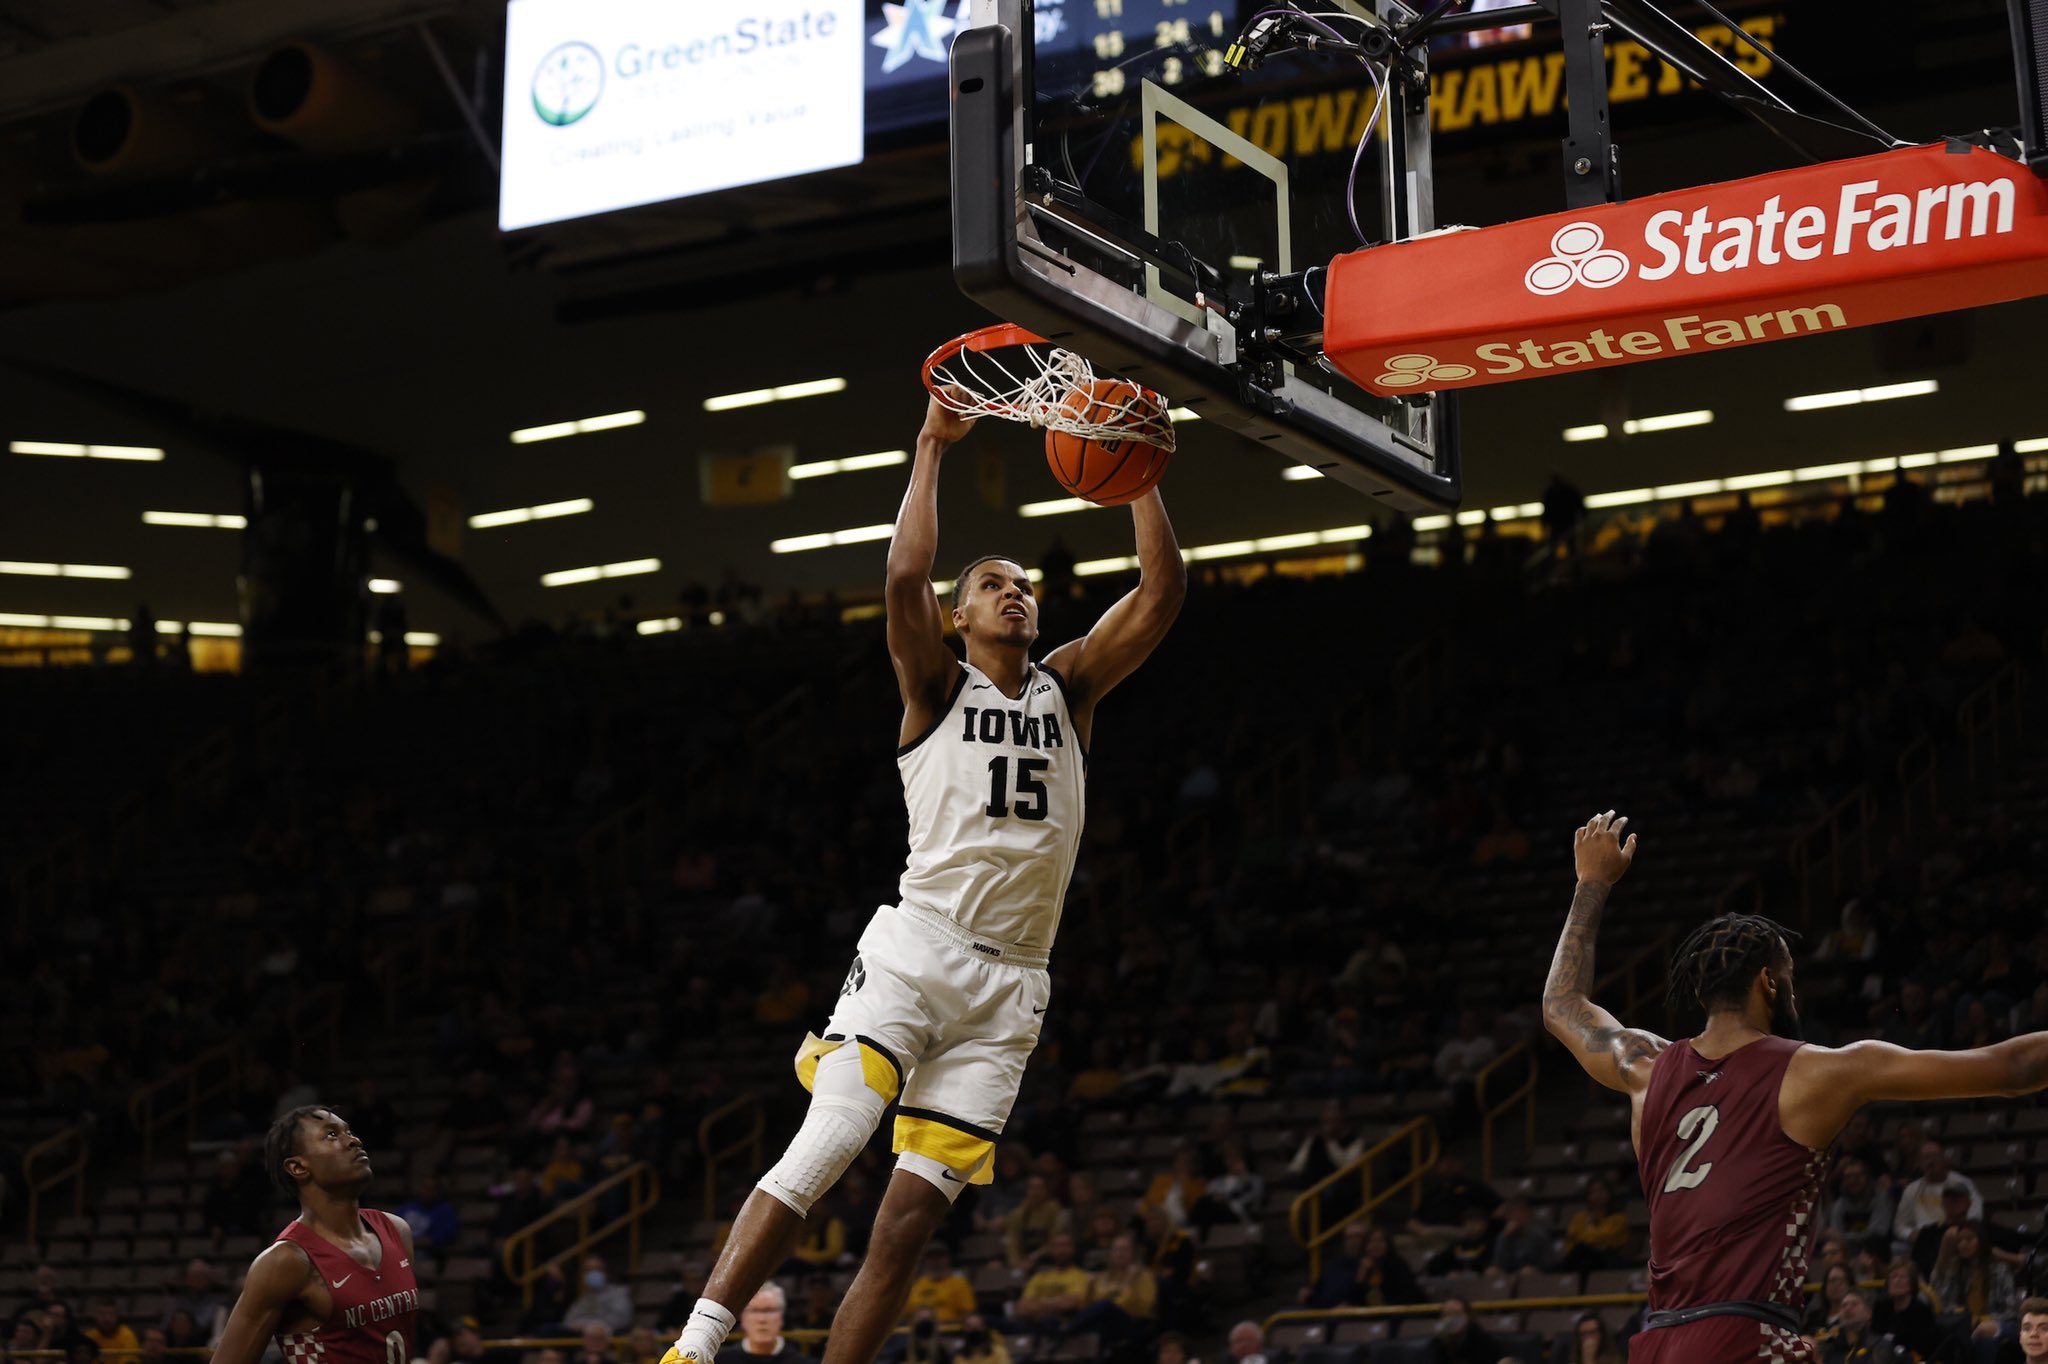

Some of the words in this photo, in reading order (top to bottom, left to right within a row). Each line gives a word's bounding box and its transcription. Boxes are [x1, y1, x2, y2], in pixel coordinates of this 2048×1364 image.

[613, 9, 838, 80] GreenState
[962, 706, 1064, 749] IOWA
[985, 755, 1050, 821] 15
[972, 942, 1001, 957] HAWKS
[1664, 1104, 1720, 1194] 2
[344, 1304, 367, 1329] NC
[370, 1287, 420, 1323] CENTRA
